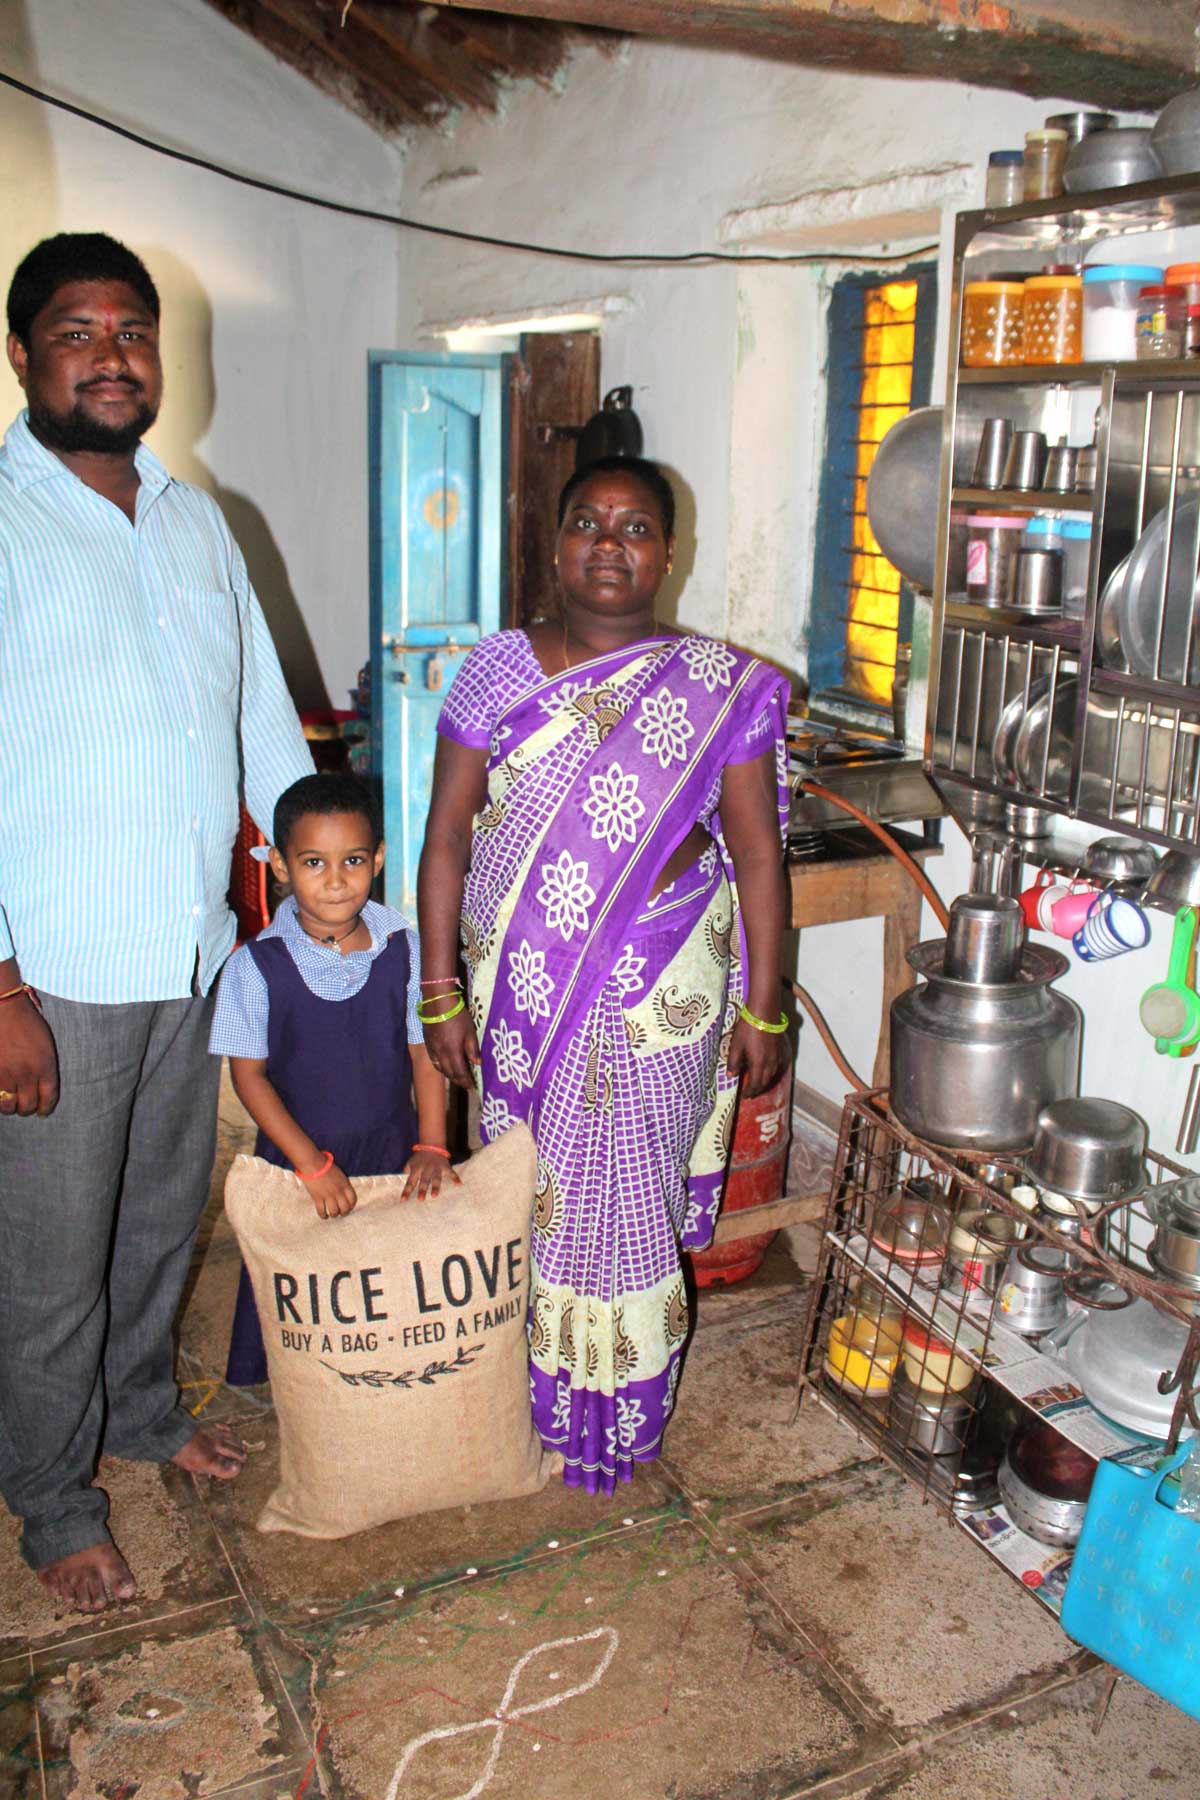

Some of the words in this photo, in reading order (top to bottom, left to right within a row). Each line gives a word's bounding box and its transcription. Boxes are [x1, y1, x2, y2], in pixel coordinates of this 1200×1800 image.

[273, 1266, 388, 1325] RICE
[412, 1238, 522, 1314] LOVE
[281, 1329, 312, 1352] BUY
[321, 1334, 333, 1353] A
[341, 1332, 378, 1353] BAG
[402, 1321, 446, 1348] FEED
[456, 1317, 468, 1338] A
[473, 1295, 522, 1333] FAMILY
